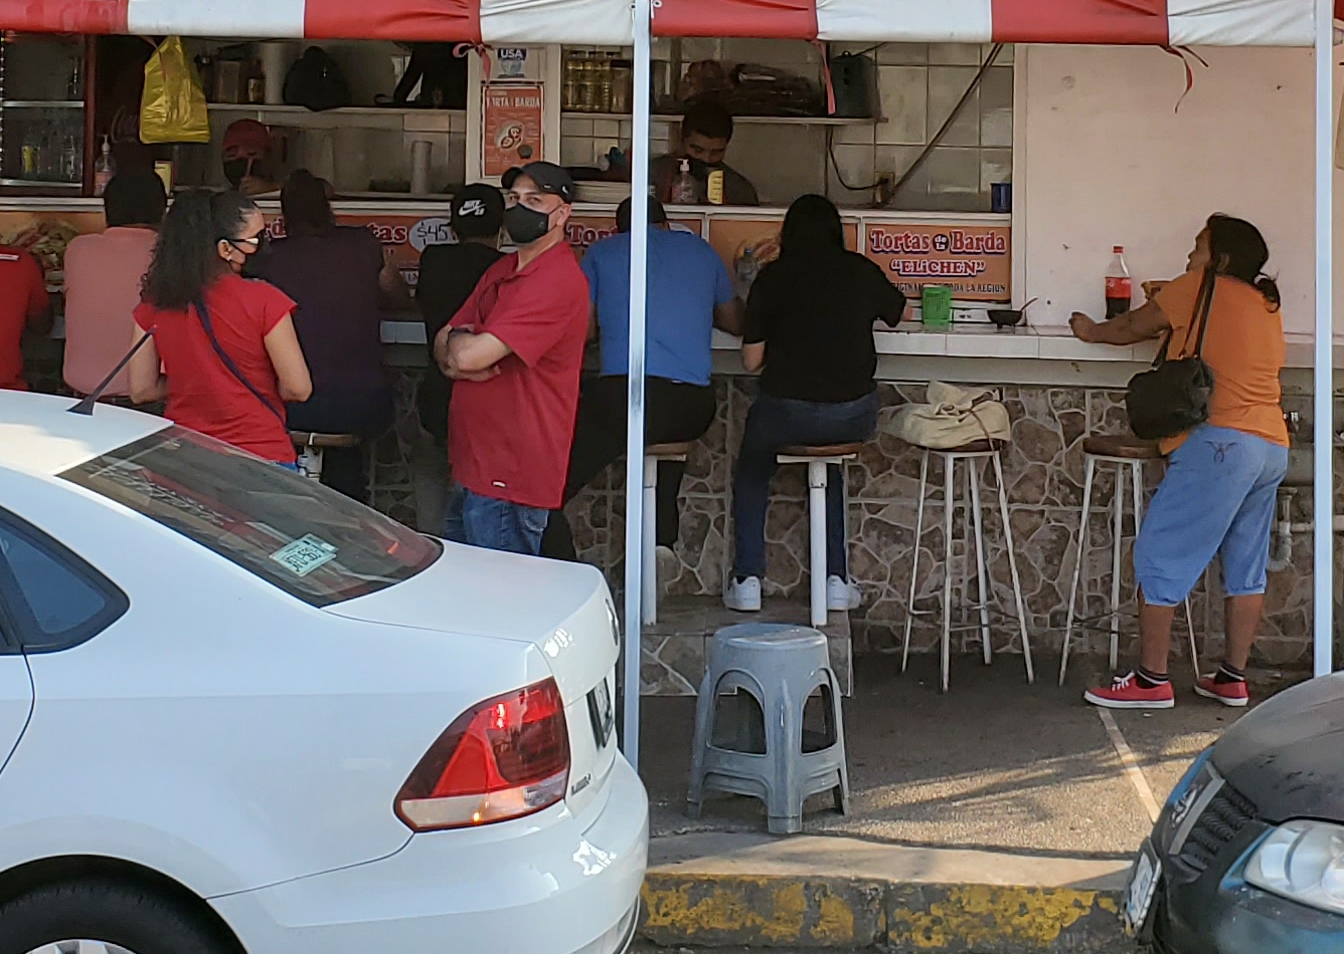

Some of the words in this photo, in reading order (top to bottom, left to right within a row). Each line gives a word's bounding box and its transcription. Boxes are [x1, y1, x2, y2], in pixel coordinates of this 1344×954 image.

[499, 49, 523, 58] USA
[870, 228, 931, 254] Tortas
[950, 229, 1007, 254] Barda
